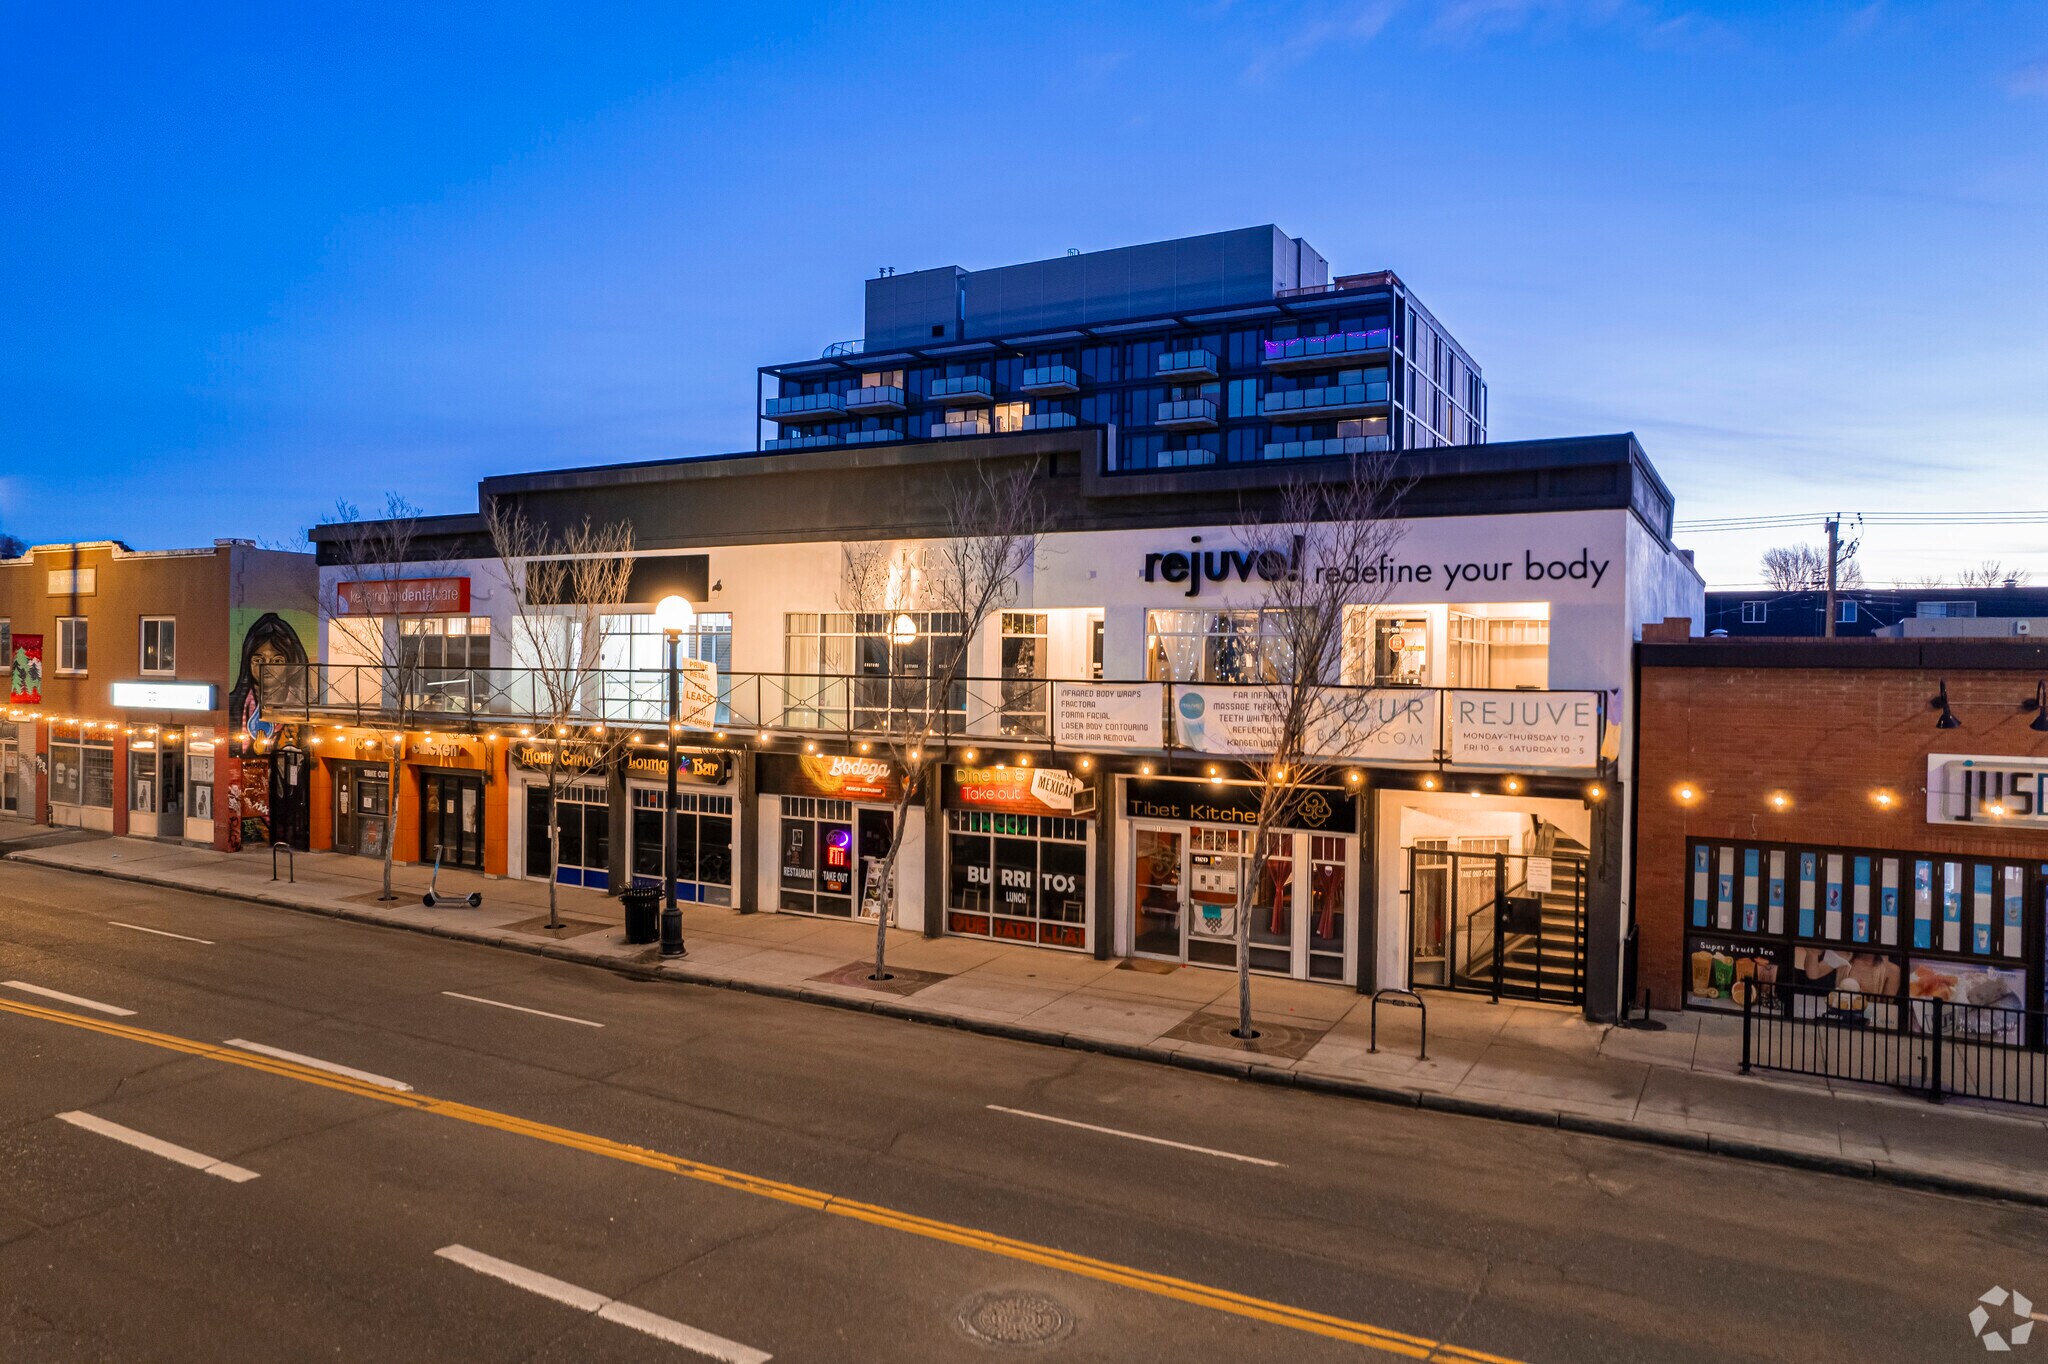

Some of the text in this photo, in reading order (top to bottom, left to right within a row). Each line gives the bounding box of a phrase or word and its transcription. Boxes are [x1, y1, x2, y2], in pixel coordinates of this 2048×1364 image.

[1144, 535, 1304, 597] rejuve!
[1315, 547, 1610, 592] redefine your body
[689, 661, 709, 671] PRIME
[689, 671, 711, 681] RETAIL
[686, 690, 712, 704] LEASE
[1061, 689, 1142, 698] INFRARED BODY WRAPS
[1233, 691, 1249, 699] FAR
[1061, 700, 1096, 708] FRACTORA
[1213, 702, 1250, 711] MASSAGE
[1318, 696, 1424, 724] YOUR
[1061, 711, 1111, 720] FORMA FACIAL
[1219, 714, 1244, 722] TEETH
[1459, 701, 1590, 727] REJUVE
[1061, 722, 1149, 732] LASER BODY CONTOURING
[1232, 726, 1283, 735] REFLEXOLOG
[1061, 733, 1137, 743] LASER HAIR REMOVAL
[1463, 744, 1478, 752] FRI
[1480, 744, 1490, 752] 10
[1498, 744, 1504, 752] 6
[1509, 744, 1557, 754] SATURDAY
[1560, 746, 1570, 754] 10
[1579, 747, 1585, 755] 5
[560, 749, 594, 768] Carlo
[627, 752, 719, 777] Loung Bar
[363, 769, 378, 778] TAKE
[829, 756, 891, 784] Bodega
[956, 768, 991, 783] Dine
[995, 769, 1009, 782] in
[962, 786, 1021, 801] Take out
[1130, 800, 1261, 824] Tibet Kitche
[783, 866, 815, 880] RESTAURANT
[823, 871, 849, 884] TAKE OUT
[1005, 890, 1027, 904] LUNCH
[1700, 941, 1725, 952] Super
[1730, 944, 1755, 954] Fruit
